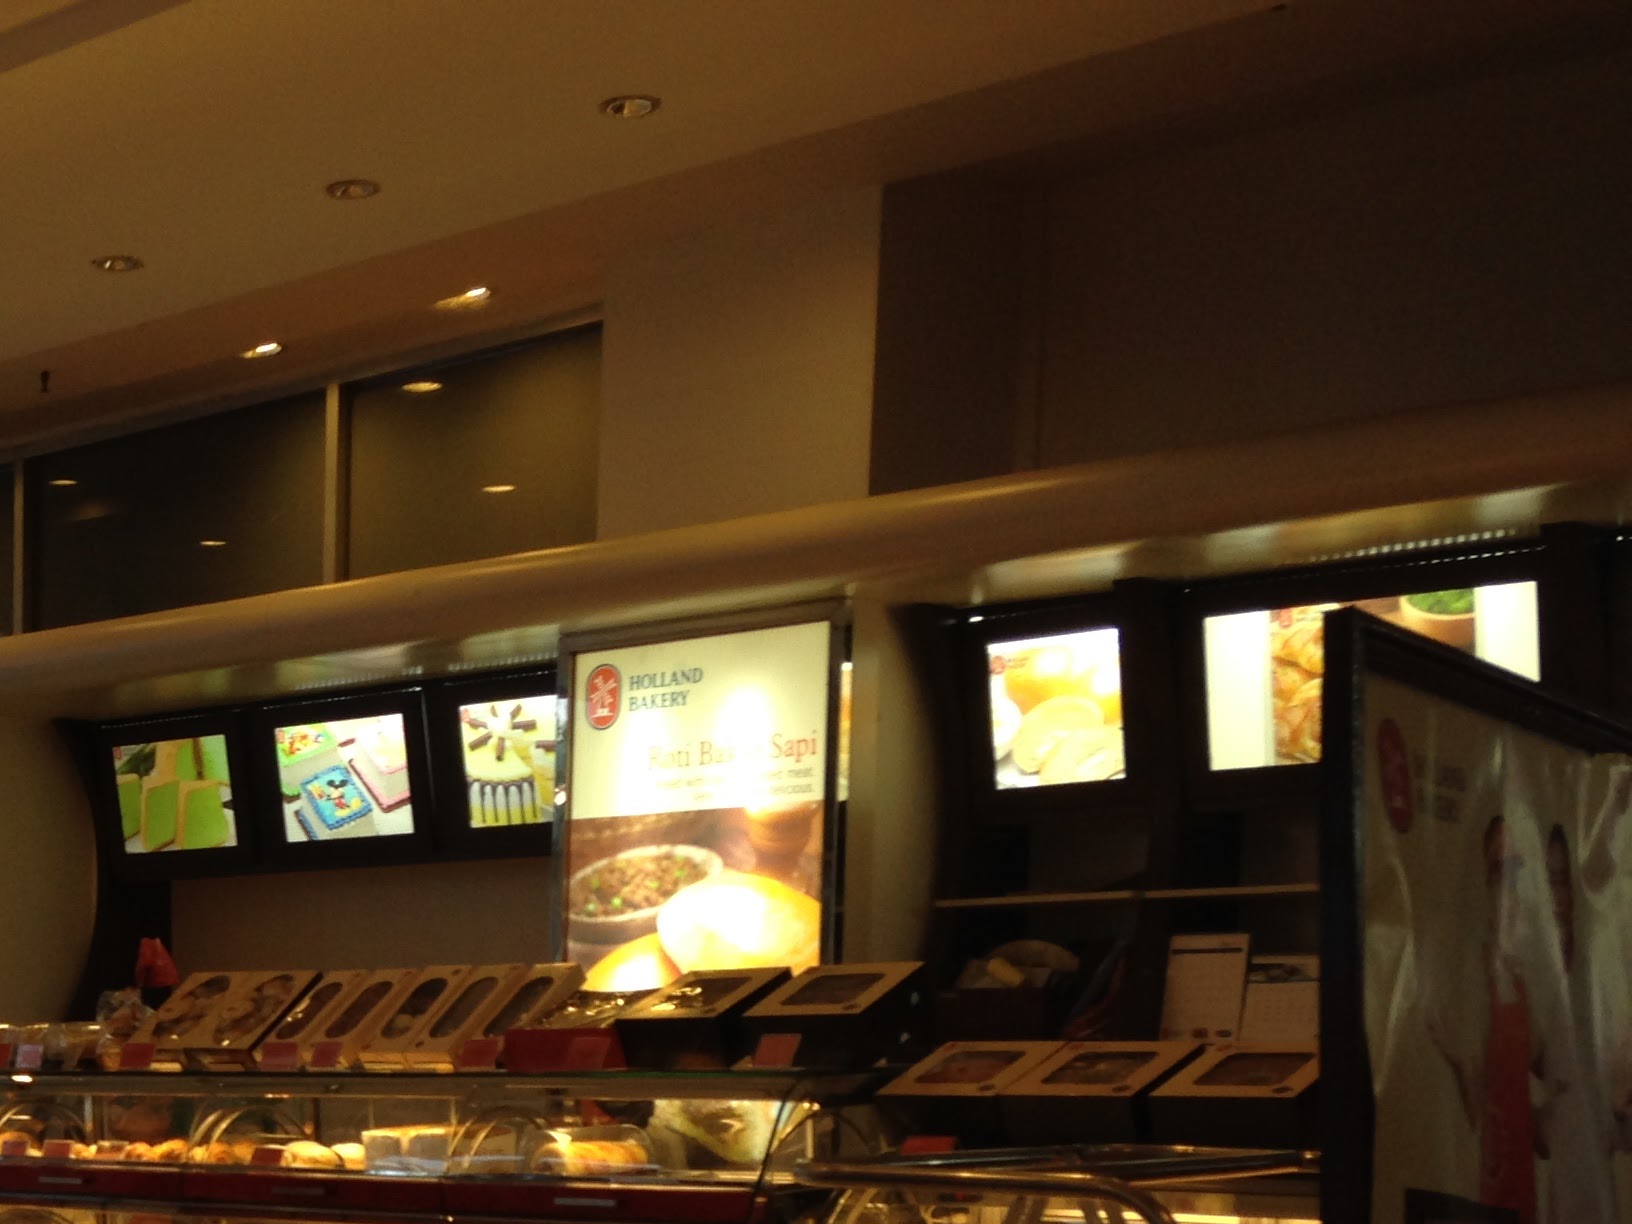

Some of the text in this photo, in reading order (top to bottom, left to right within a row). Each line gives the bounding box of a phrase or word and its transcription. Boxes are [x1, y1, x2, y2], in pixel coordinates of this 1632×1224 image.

[629, 667, 703, 691] HOLLAND
[629, 690, 690, 711] BAKERY
[771, 729, 818, 763] Sapi
